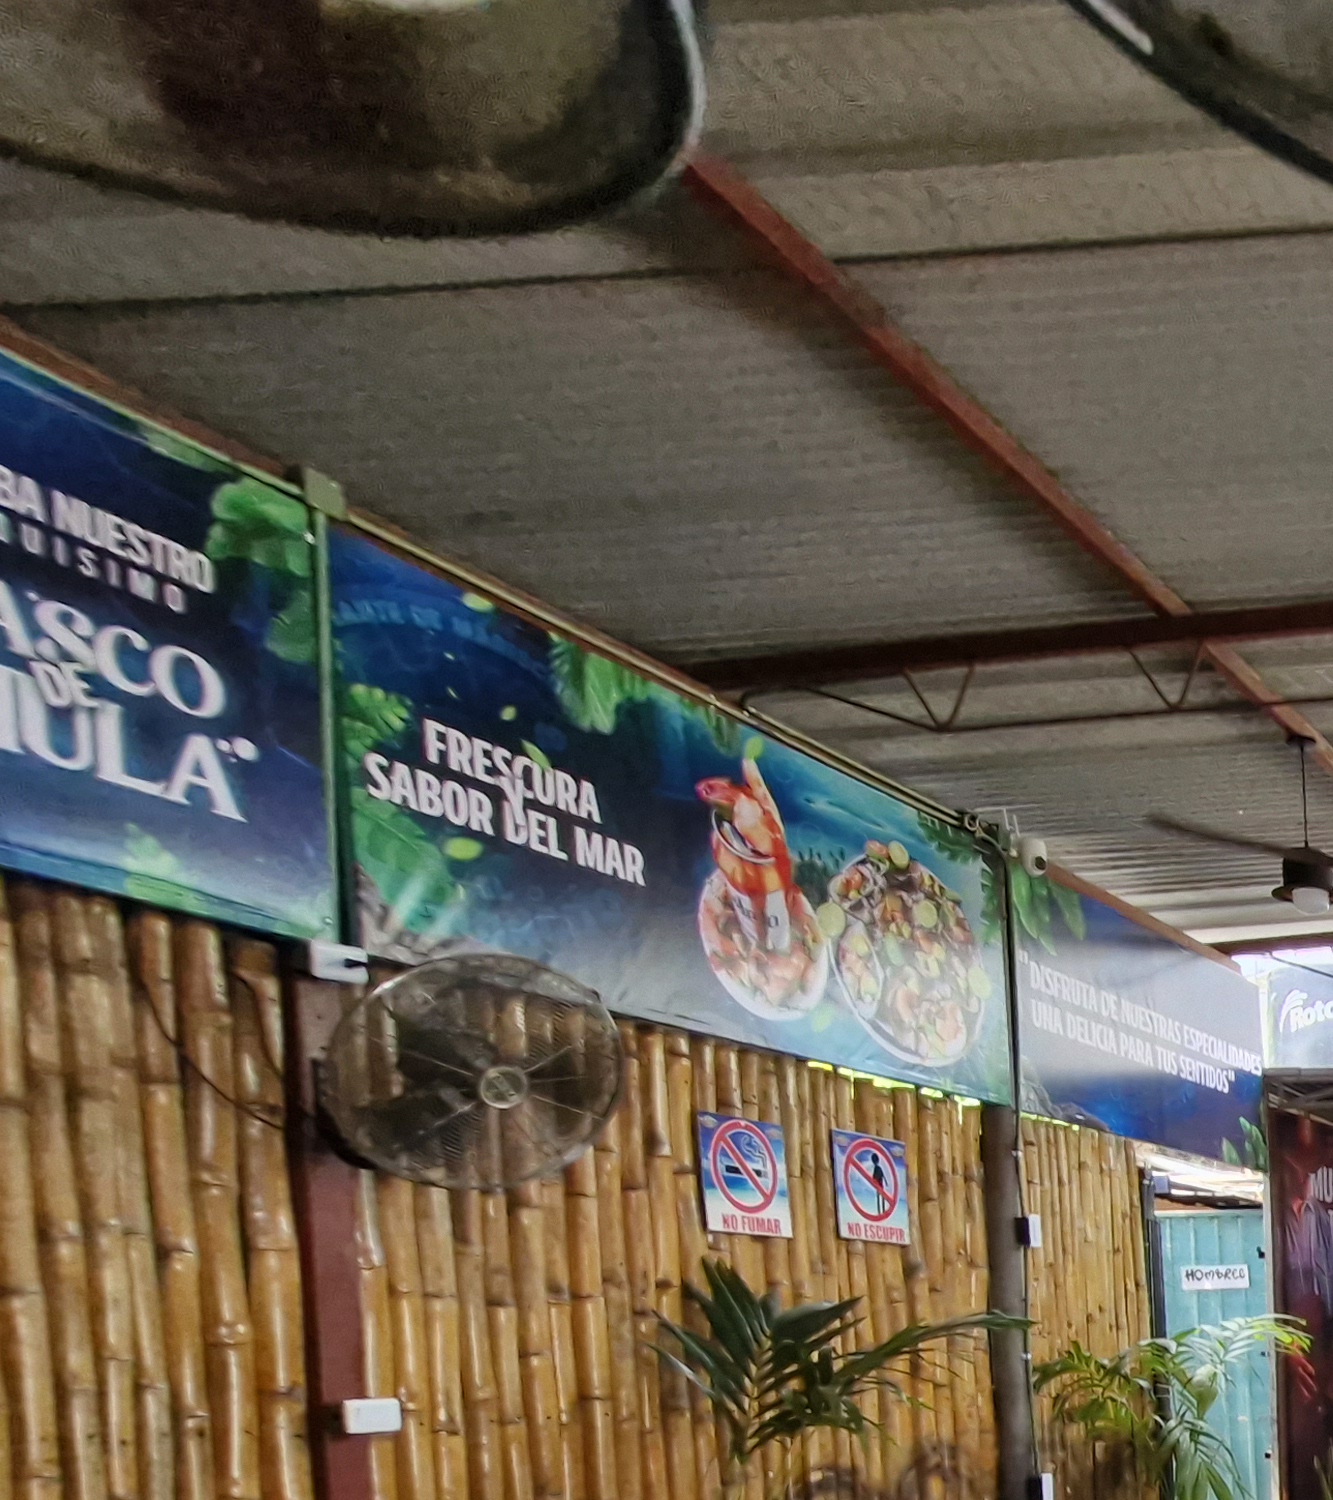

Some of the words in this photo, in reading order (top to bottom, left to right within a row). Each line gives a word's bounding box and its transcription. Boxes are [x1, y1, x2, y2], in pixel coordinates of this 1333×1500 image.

[51, 489, 217, 594] NUESTRO
[30, 660, 98, 708] DE
[423, 717, 603, 824] FRESCURA
[363, 751, 495, 836] SABOR
[503, 799, 569, 861] DEL
[574, 825, 647, 887] MAR
[1031, 999, 1063, 1037] UNA
[1065, 1012, 1117, 1055] DELICIA
[1119, 1031, 1153, 1067] PARA
[1155, 1045, 1178, 1075] TUS
[1100, 988, 1119, 1022] DE
[1121, 999, 1181, 1046] NUESTRAS
[1183, 1023, 1262, 1077] ESPECIALIDADES
[721, 1212, 738, 1231] NO
[741, 1214, 782, 1236] FUMAR
[848, 1221, 862, 1238] NO
[864, 1224, 906, 1243] ESCUPIR
